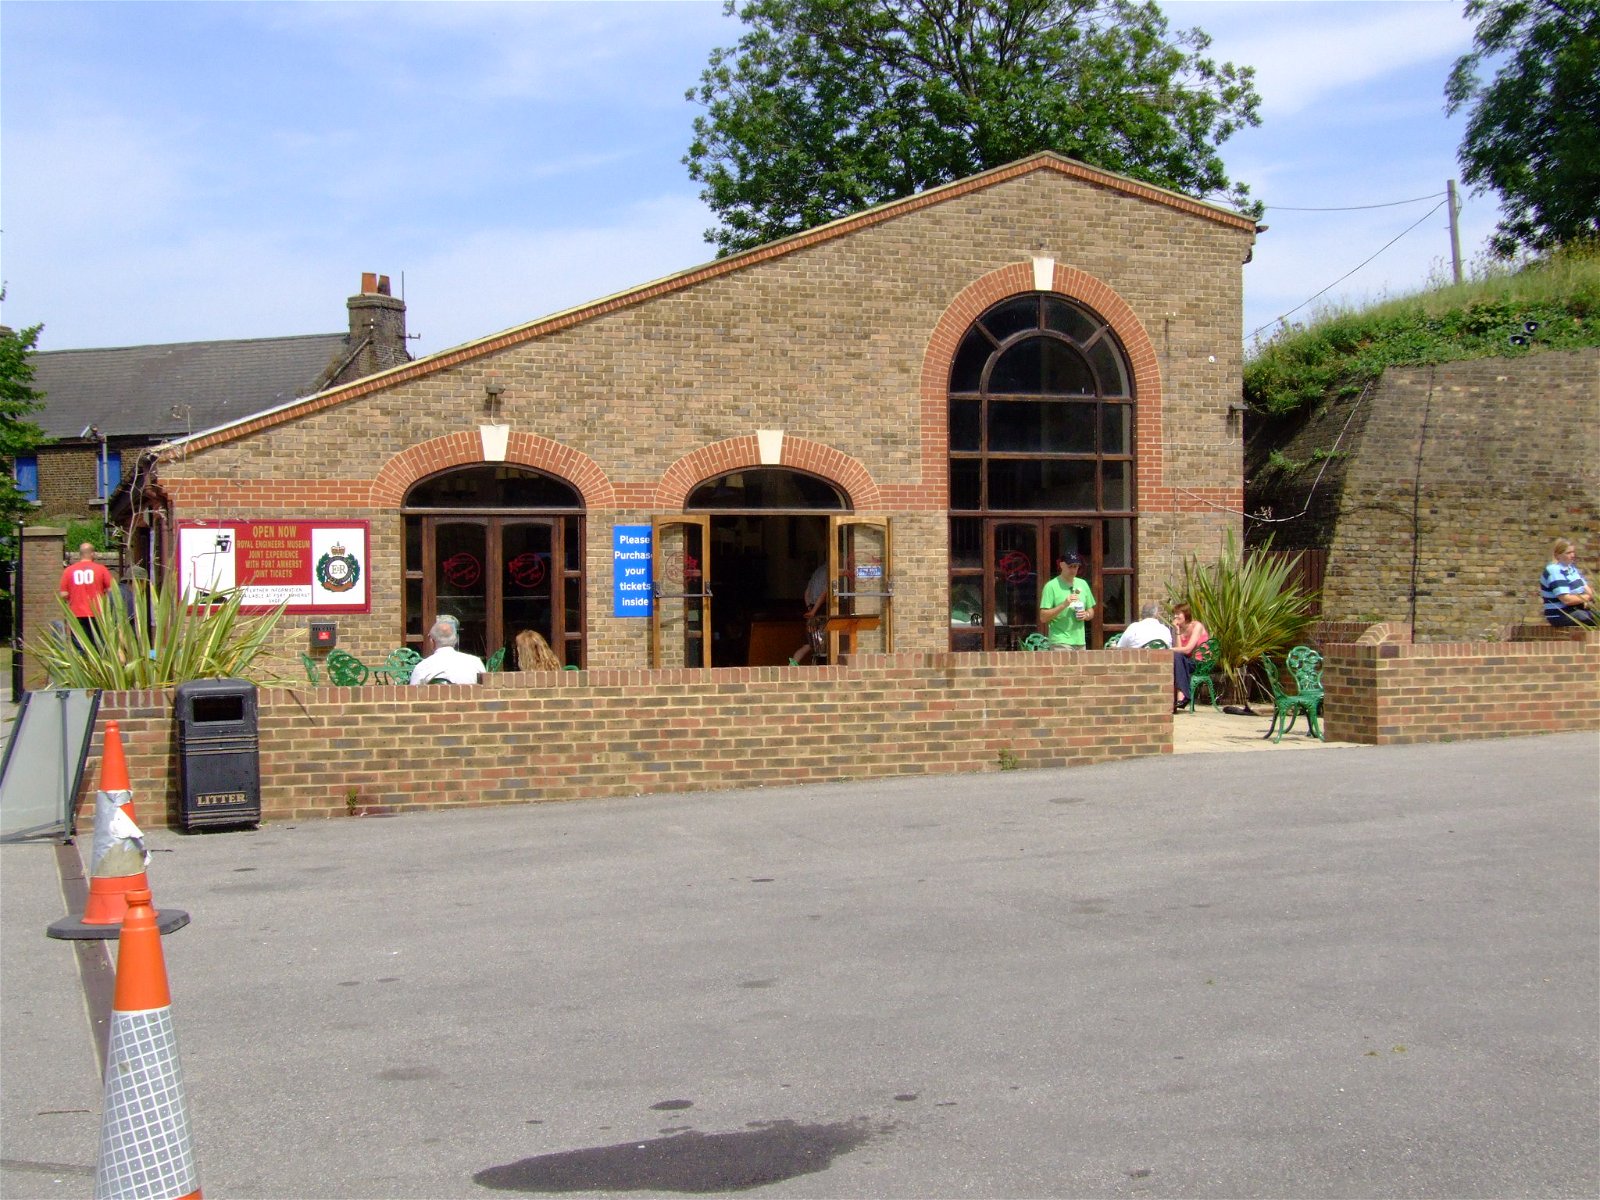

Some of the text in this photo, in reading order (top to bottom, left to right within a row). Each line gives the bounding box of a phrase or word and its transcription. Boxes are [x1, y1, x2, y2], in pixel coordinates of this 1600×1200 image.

[253, 525, 297, 538] OPEN NOW
[236, 540, 310, 549] ROYAL ENGINEERS MUSEUM
[619, 535, 651, 545] Please
[249, 550, 299, 559] JOINT EXPERIENCE
[245, 559, 302, 569] WITH FORT AMHERST
[270, 569, 293, 578] TICKETS
[625, 568, 645, 577] your
[619, 581, 651, 591] tickets
[622, 597, 649, 607] inside
[196, 793, 246, 806] LITTER
